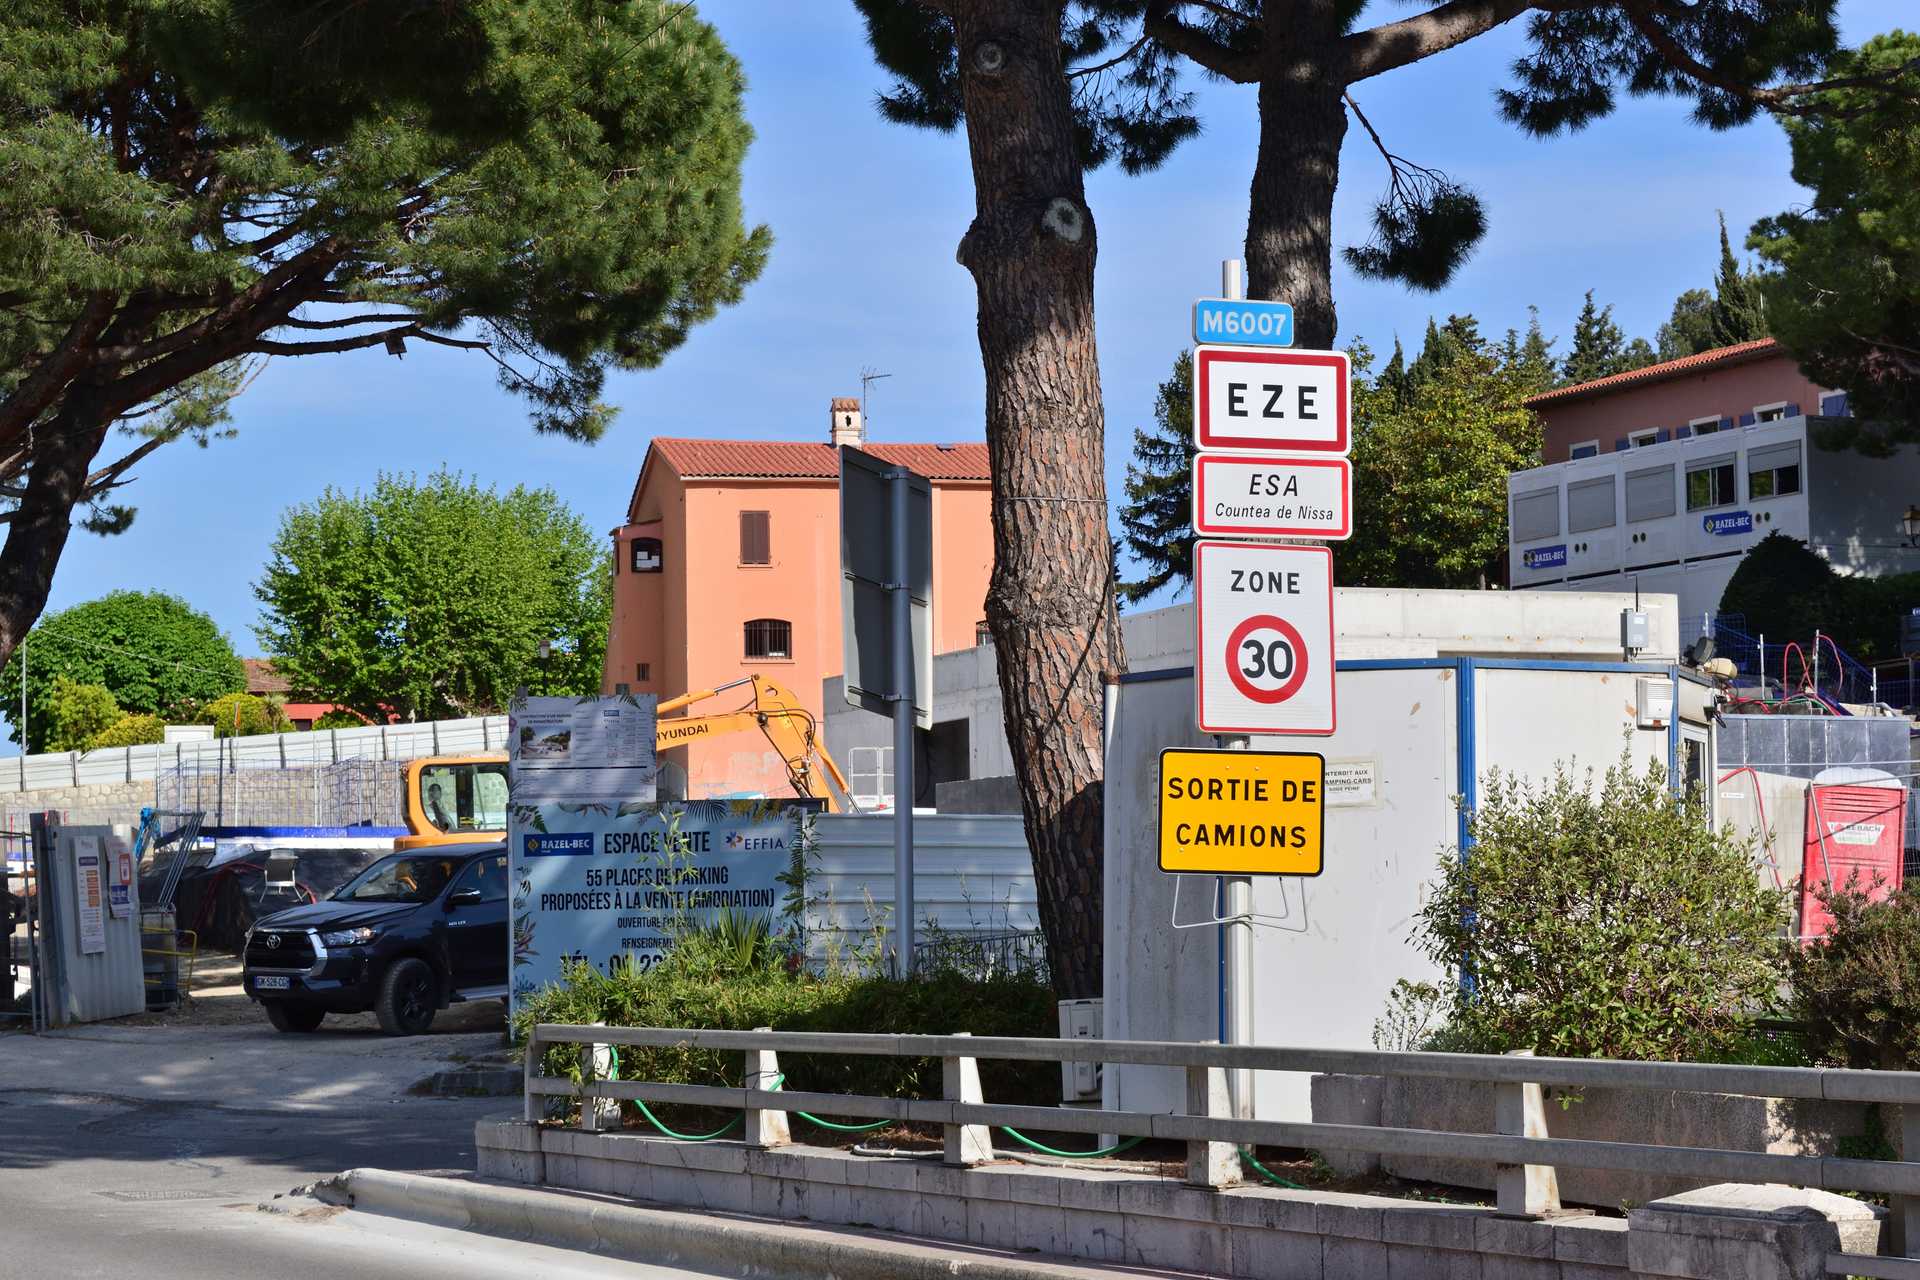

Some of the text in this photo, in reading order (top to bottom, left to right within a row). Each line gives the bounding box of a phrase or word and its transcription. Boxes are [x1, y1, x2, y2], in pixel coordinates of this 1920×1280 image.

[1203, 310, 1286, 336] M6007
[1228, 382, 1318, 420] EZE
[1249, 474, 1298, 496] ESA
[1215, 502, 1333, 520] Countea de Nissa
[1231, 570, 1300, 594] ZONE
[1242, 639, 1293, 680] 30
[1168, 777, 1317, 803] SORTIE DE
[540, 838, 590, 850] RAZEL-BEC
[603, 831, 660, 855] ESPACE
[744, 837, 784, 850] EFFIA
[1176, 823, 1307, 849] CAMIONS
[586, 869, 602, 887] 55
[605, 867, 653, 887] PLACES
[541, 889, 611, 912] PROPOSÉES
[614, 889, 623, 911] À
[626, 892, 642, 910] LA
[617, 916, 660, 929] OUVERTURE
